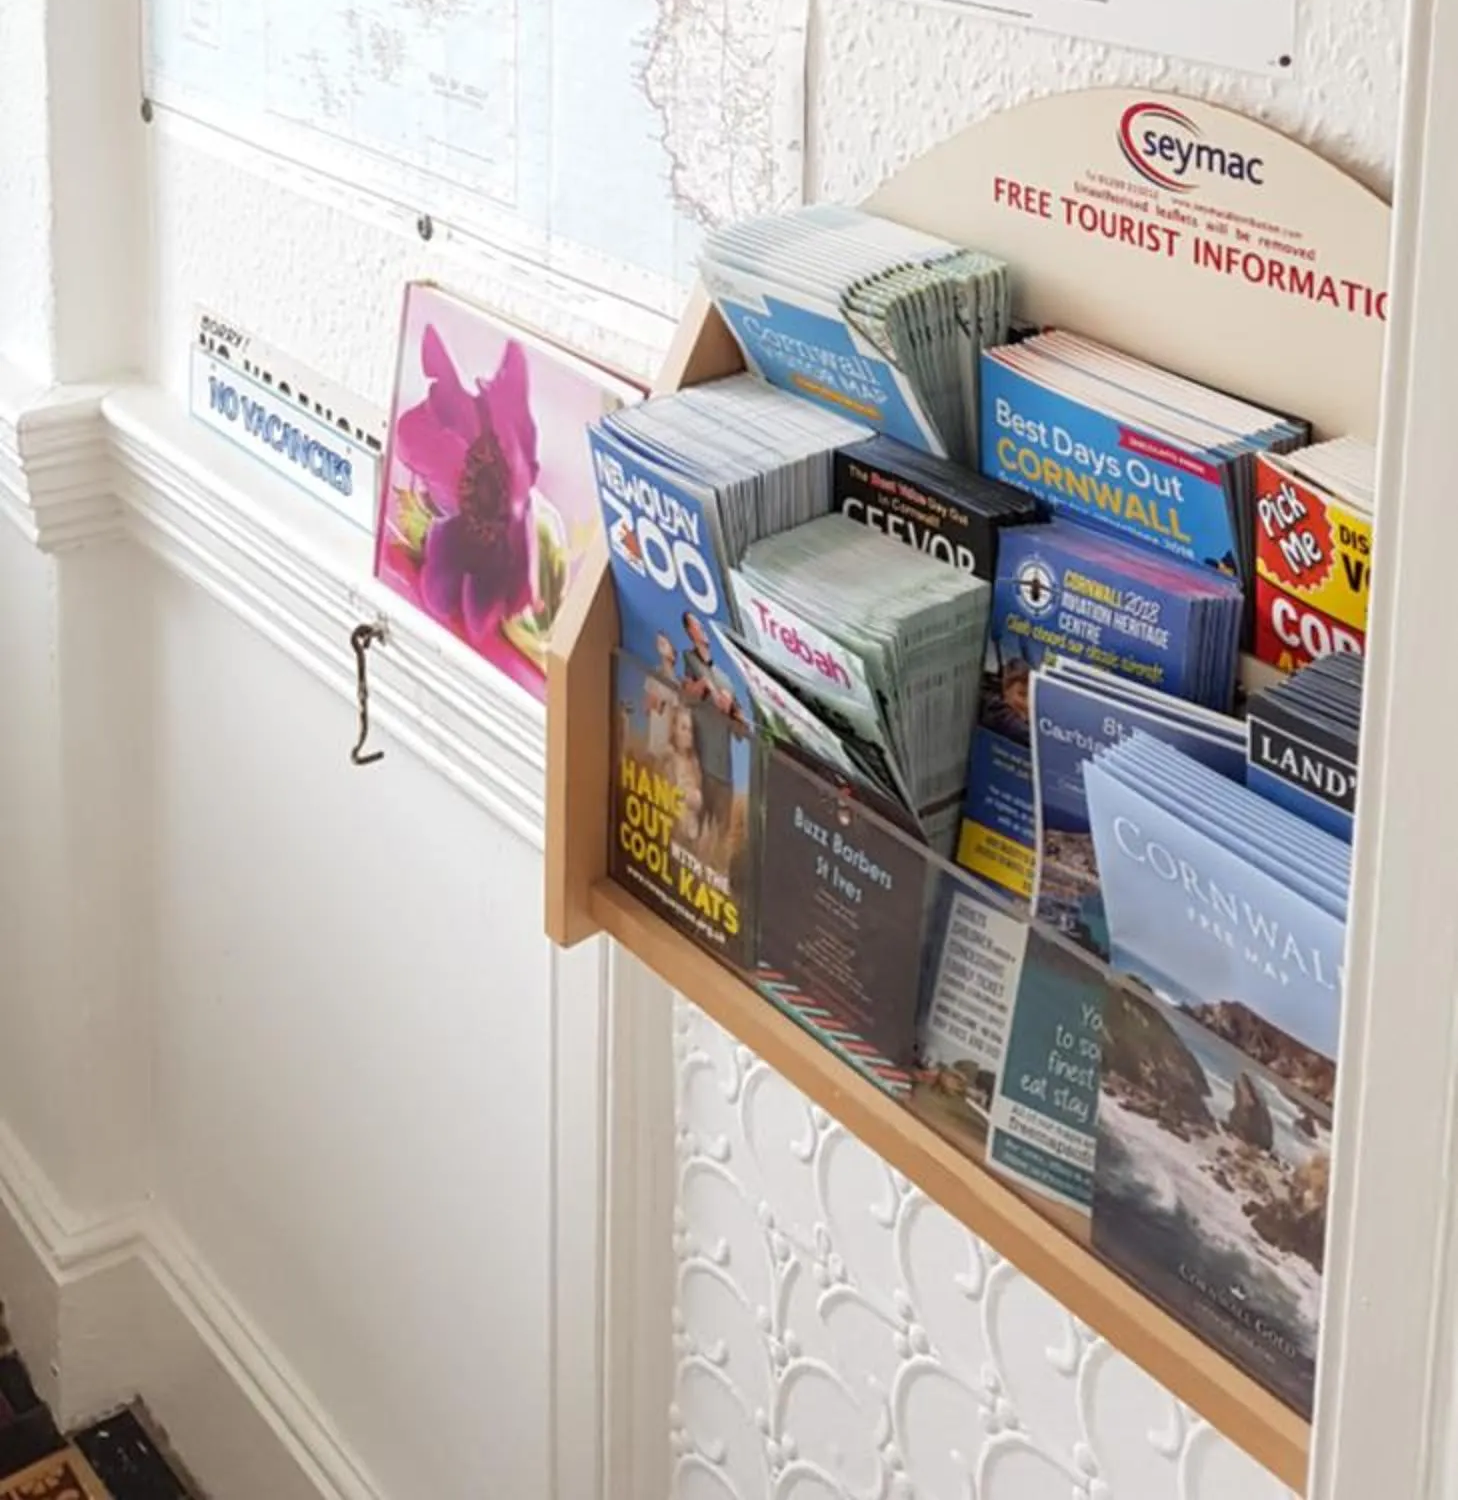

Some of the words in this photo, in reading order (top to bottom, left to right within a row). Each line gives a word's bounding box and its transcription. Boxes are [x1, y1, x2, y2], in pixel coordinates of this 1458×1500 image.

[1142, 127, 1265, 186] seymac
[993, 176, 1053, 219] FREE
[1060, 196, 1181, 258] TOURIST
[1236, 227, 1251, 242] be
[1258, 236, 1317, 261] removed
[208, 375, 240, 422] NO
[240, 395, 353, 497] VACANCIES
[994, 397, 1052, 450] Best
[1052, 427, 1121, 480] Days
[1126, 460, 1185, 503] Out
[594, 448, 699, 546] NEWQUAY
[848, 463, 869, 483] The
[996, 437, 1194, 544] CORNWALL
[1256, 480, 1308, 538] Pick
[601, 486, 719, 616] ZOO
[1278, 530, 1323, 576] Me
[1342, 553, 1371, 593] V
[750, 596, 852, 690] Trebah
[1058, 610, 1102, 646] CENTRE
[1112, 610, 1171, 650] HERITAGE
[620, 754, 687, 820] HANG
[625, 793, 674, 846] OUT
[793, 805, 829, 848] Buzz
[832, 830, 894, 891] Barbers
[619, 820, 674, 886] COOL
[679, 866, 740, 935] KATS
[815, 854, 829, 881] St
[831, 866, 863, 904] Ives
[1113, 816, 1344, 992] CORNWAL
[1186, 904, 1236, 950] FREE
[1243, 946, 1290, 987] MAP
[1055, 1023, 1075, 1050] to
[1048, 1049, 1095, 1092] finest
[1053, 1086, 1090, 1124] stay
